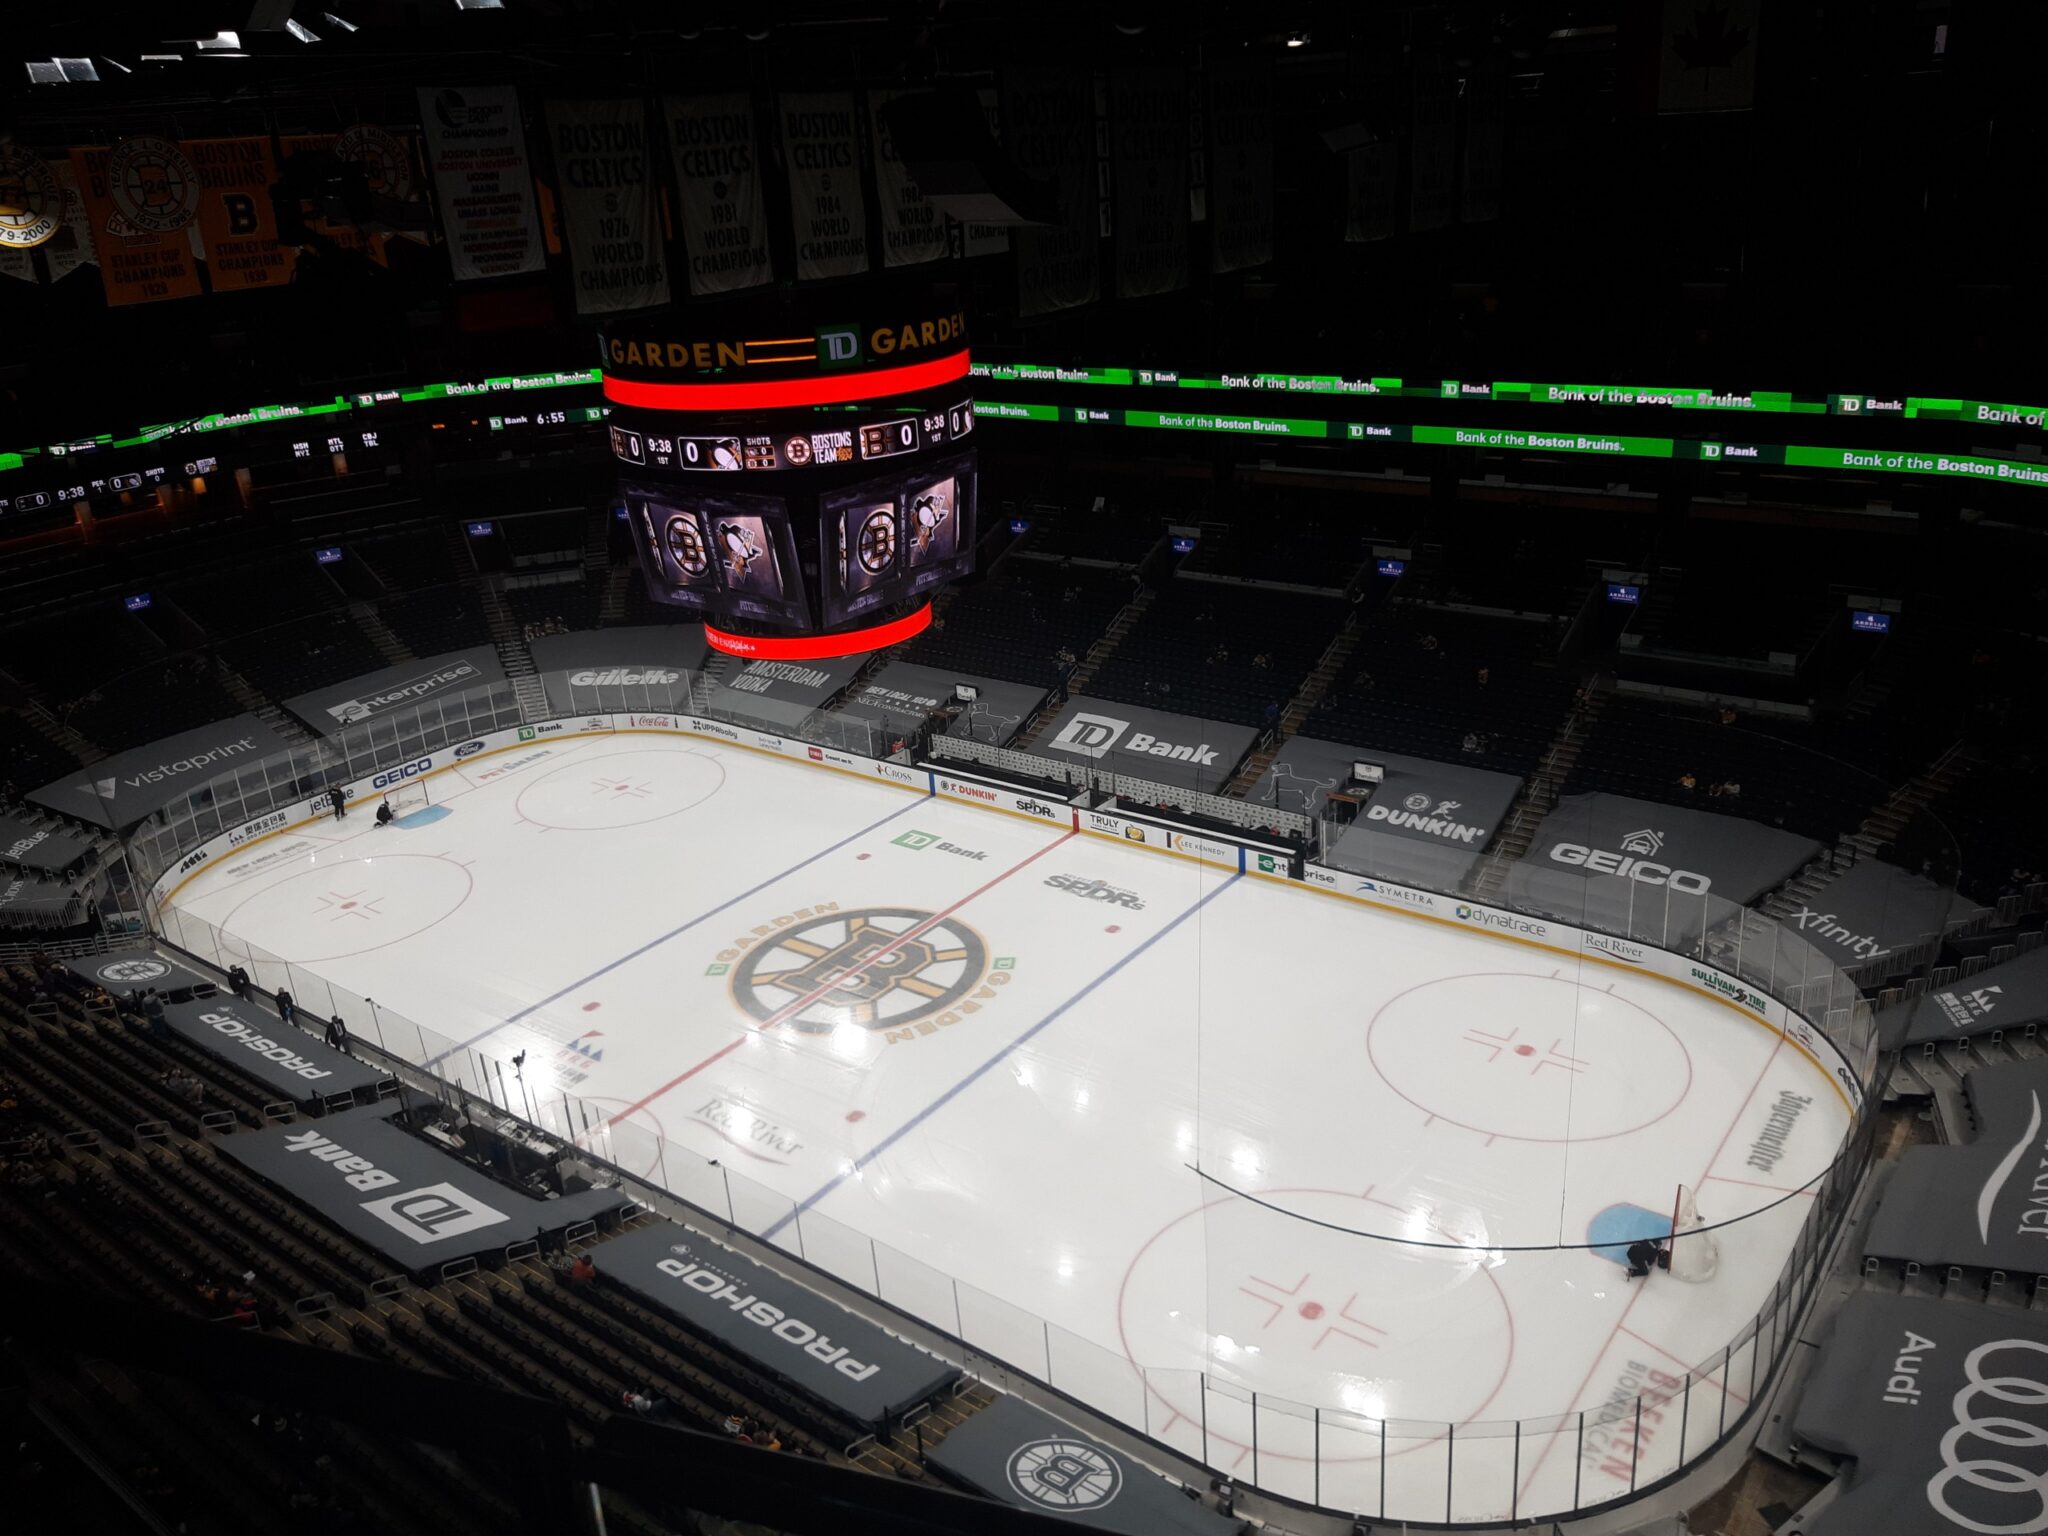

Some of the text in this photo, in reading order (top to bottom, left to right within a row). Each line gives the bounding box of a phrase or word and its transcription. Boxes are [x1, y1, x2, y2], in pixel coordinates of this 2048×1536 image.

[674, 114, 749, 146] BOSTON
[788, 111, 849, 139] BOSTON
[558, 121, 641, 152] BOSTON
[682, 145, 751, 178] CELTICS
[794, 142, 850, 171] CELTICS
[567, 156, 644, 188] CELTICS
[145, 180, 168, 195] 24
[711, 203, 738, 225] 1981
[816, 196, 841, 215] 1984
[704, 226, 750, 250] WORLD
[810, 218, 849, 239] WORLD
[592, 241, 644, 264] WORLD
[801, 238, 865, 261] CHAMPIONS
[693, 247, 768, 275] CHAMPIONS
[579, 263, 664, 291] CHAMPIONS
[611, 312, 965, 367] GARDEN TD GARDEN
[512, 377, 554, 389] Boston
[1020, 369, 1055, 380] Boston
[1155, 373, 1177, 382] Bank
[1222, 376, 1380, 393] Bank of the Boston Bruins.
[376, 391, 399, 402] Bank
[1462, 384, 1490, 394] Bank
[1548, 388, 1756, 408] Bank of the Boston Bruins.
[1000, 405, 1030, 417] Bruins.
[1866, 399, 1903, 411] Bank
[1977, 405, 2046, 425] Bank of
[504, 416, 528, 425] Bank
[537, 412, 566, 425] 6:55
[924, 414, 945, 432] 9:38
[1089, 411, 1109, 420] Bank
[1159, 415, 1290, 433] Bank of the Boston Bruins.
[362, 432, 378, 440] CBJ
[747, 437, 771, 446] SHOTS
[812, 432, 852, 449] BOSTONS
[901, 425, 912, 446] 0
[931, 433, 942, 443] 1ST
[1366, 427, 1392, 437] Bank
[1456, 431, 1625, 452] Bank of the Boston Bruins.
[363, 440, 379, 448] TBL
[631, 437, 639, 456] 0
[648, 438, 672, 453] 9:38
[687, 442, 698, 462] 0
[1725, 446, 1758, 457] Bank
[657, 457, 669, 465] 1ST
[814, 448, 838, 464] TEAM
[1843, 452, 1882, 467] Bank
[1887, 456, 1903, 468] of
[1907, 457, 1933, 470] the
[1937, 458, 1994, 475] Boston
[58, 486, 85, 501] 9:38
[114, 479, 121, 489] 0
[36, 494, 44, 505] 0
[571, 669, 679, 687] Gillette
[729, 674, 774, 693] VODKA
[744, 660, 831, 688] AMSTERDAM
[342, 664, 473, 716] enterprise
[885, 690, 912, 702] LOCAL
[538, 723, 563, 733] Bank
[1072, 718, 1220, 766] TD Bank
[124, 738, 257, 788] vistaprint
[373, 757, 432, 789] GEICO
[958, 781, 998, 801] DUNKIN'
[1090, 814, 1119, 828] TRULY
[1367, 805, 1485, 843] DUNKIN'
[902, 832, 989, 861] TD Bank
[1181, 841, 1226, 857] LEE KENNEDY
[1550, 843, 1711, 895] GEICO
[1378, 885, 1434, 906] SYMETRA
[716, 901, 840, 962] GARDEN
[1473, 909, 1546, 938] dynatrace
[1790, 906, 1891, 960] xfinity
[1585, 933, 1644, 957] Red River
[1691, 967, 1766, 1010] SULLIVAN TIRE
[1718, 985, 1733, 998] AUTO
[887, 971, 1012, 1044] GARDEN
[199, 1013, 333, 1080] PROSHOP
[750, 1119, 804, 1156] River
[284, 1130, 474, 1236] Bank TD
[656, 1258, 880, 1382] PROSHOP
[1883, 1330, 1937, 1406] Audi
[1600, 1369, 1681, 1482] BEEKEN
